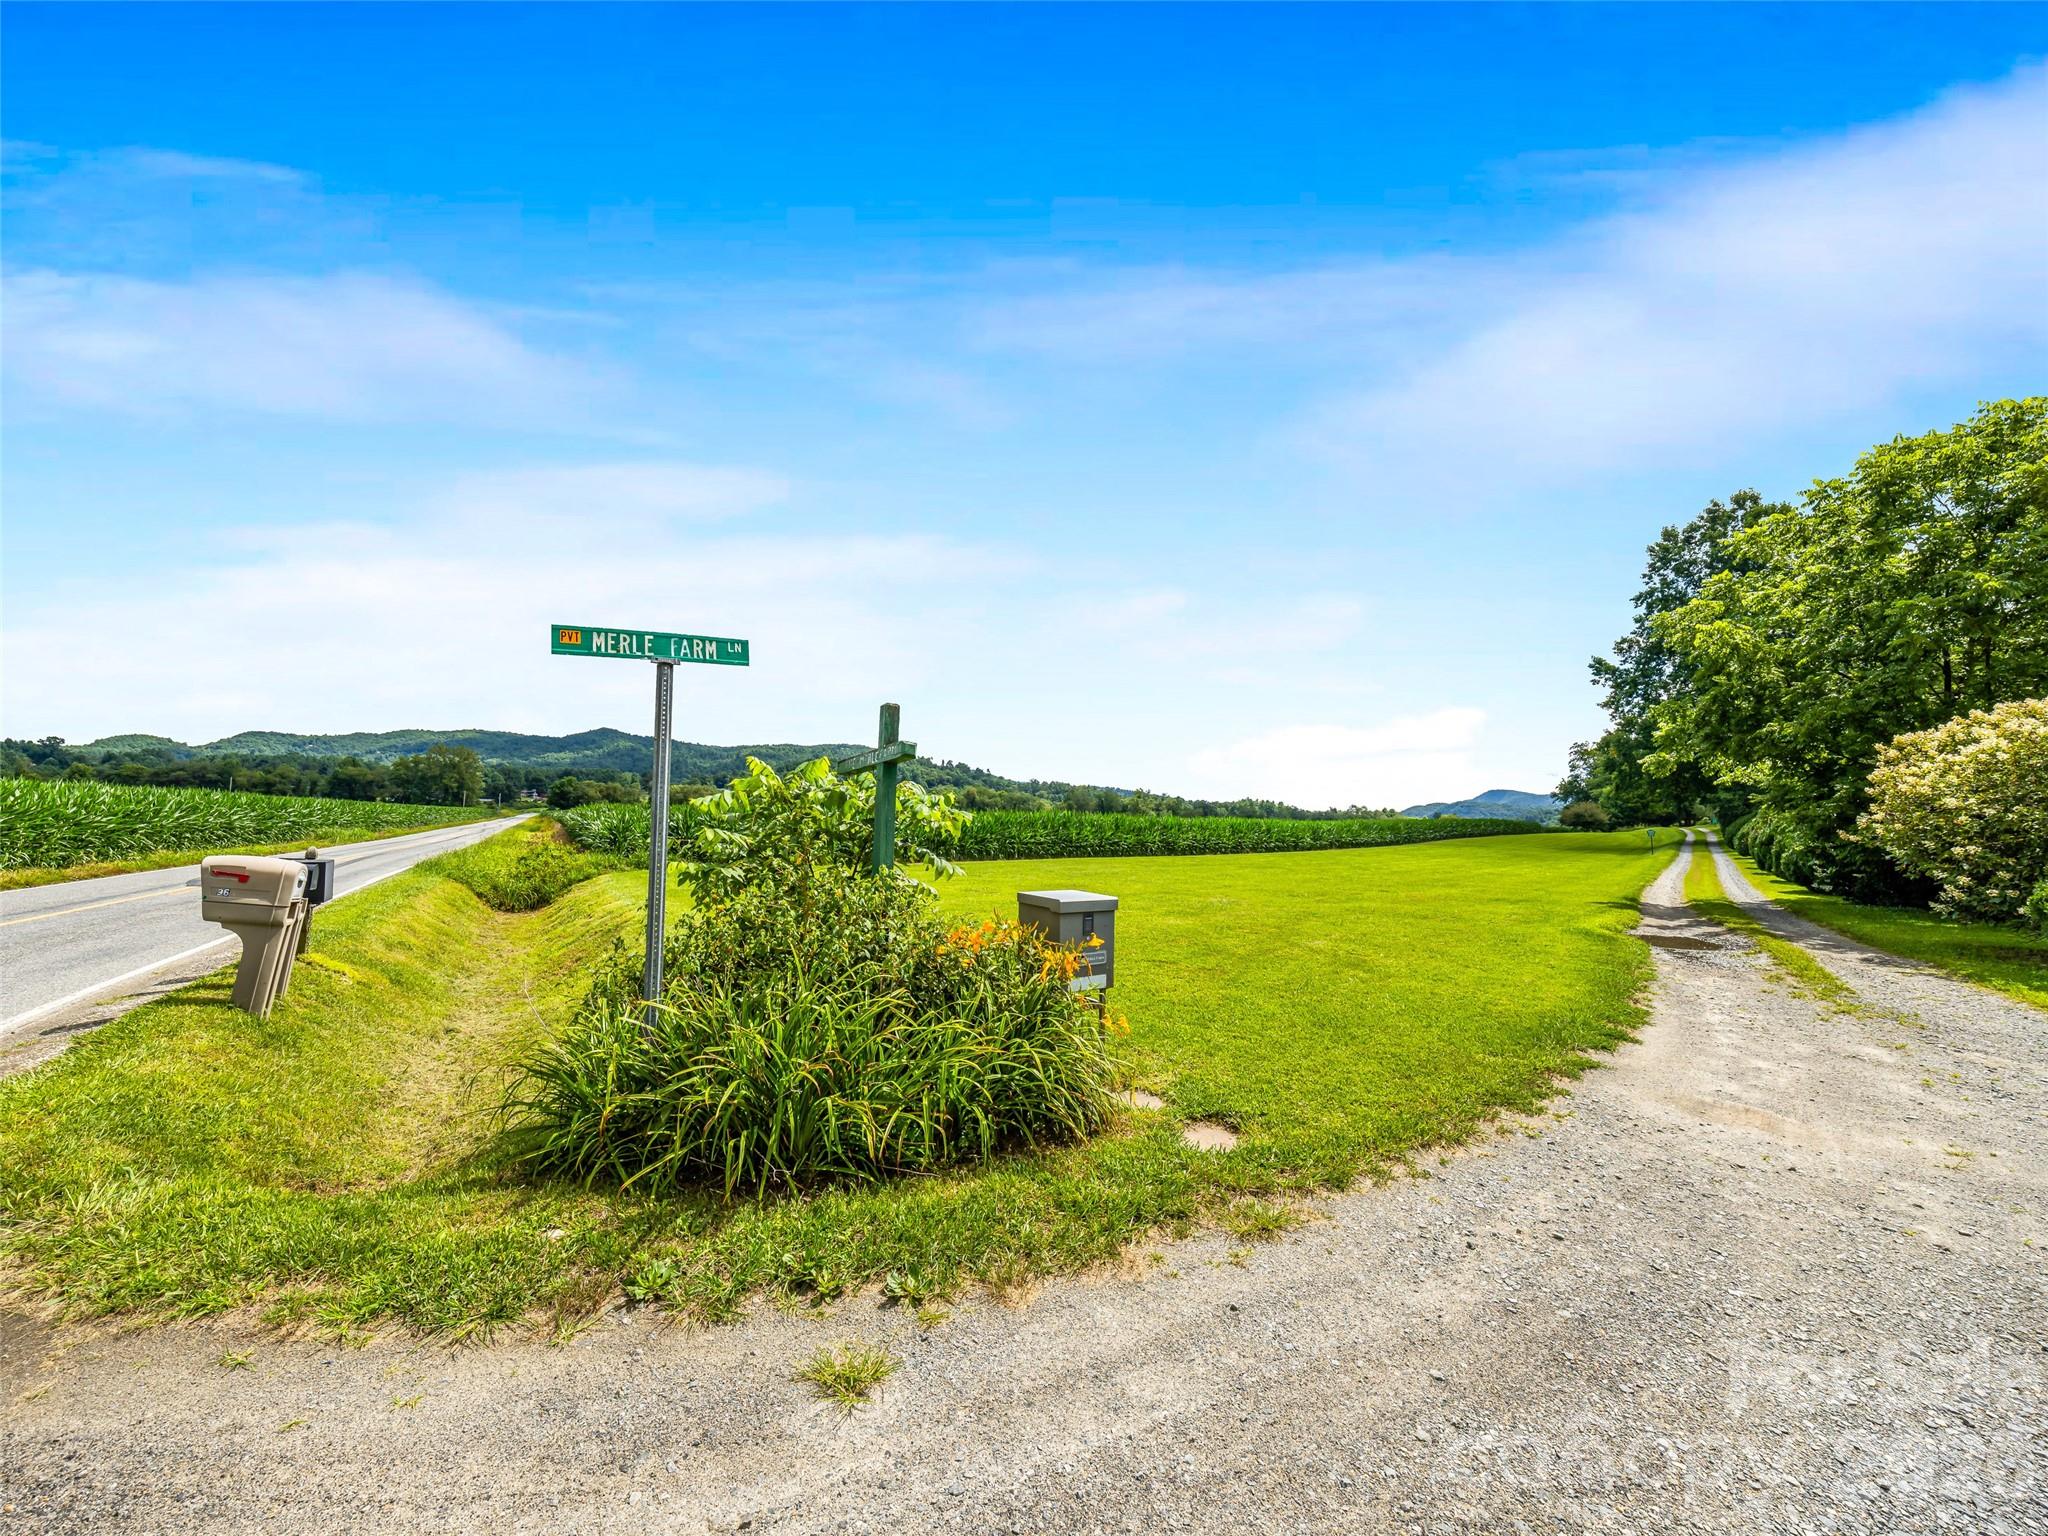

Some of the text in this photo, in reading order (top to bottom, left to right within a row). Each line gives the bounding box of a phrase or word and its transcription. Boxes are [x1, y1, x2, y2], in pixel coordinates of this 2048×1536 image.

[560, 631, 742, 660] PVT MERLE FARM LN
